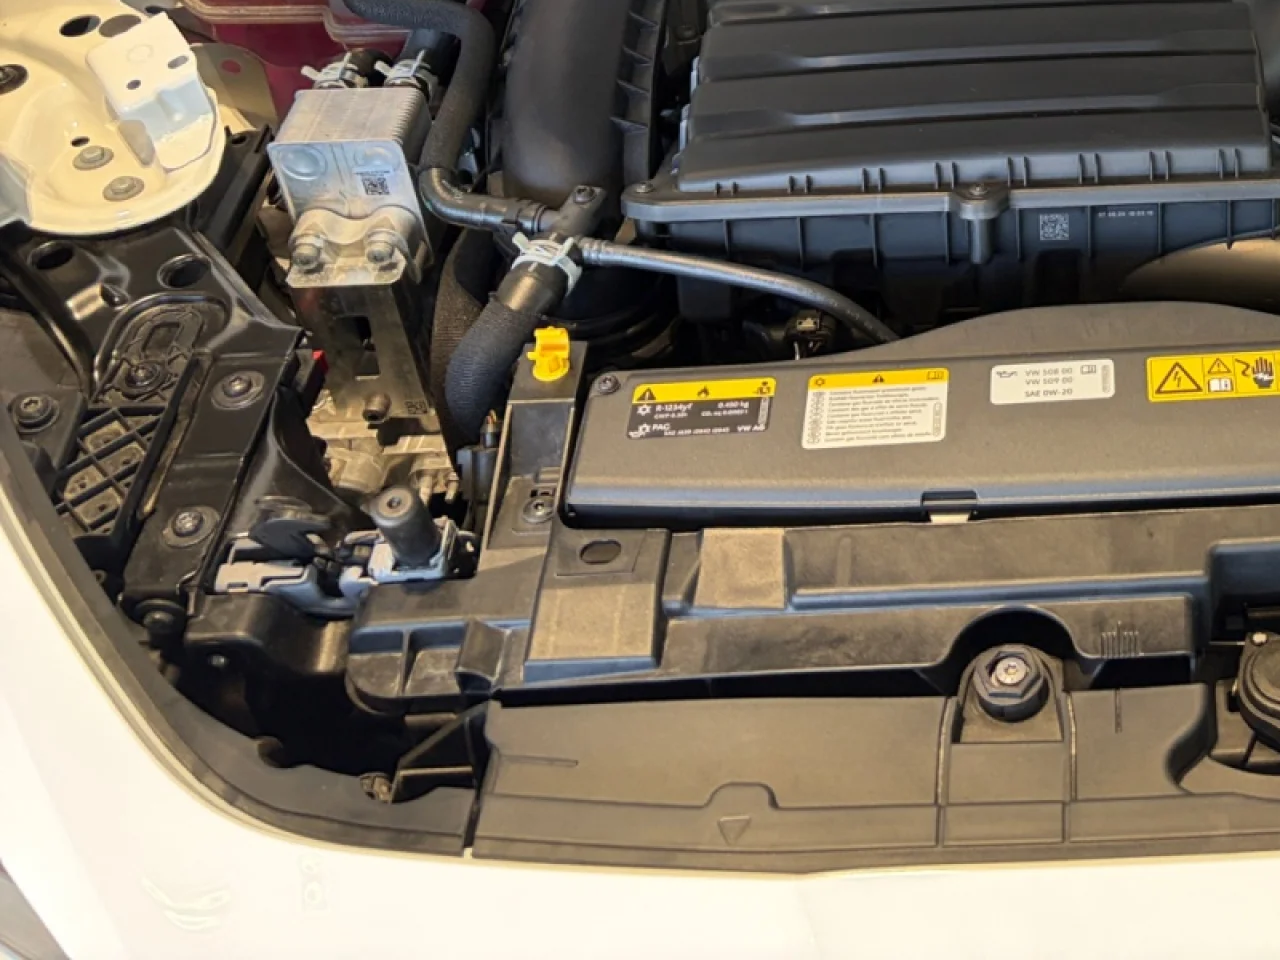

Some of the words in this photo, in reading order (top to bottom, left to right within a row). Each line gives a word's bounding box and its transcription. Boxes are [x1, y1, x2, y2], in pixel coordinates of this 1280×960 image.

[1025, 368, 1040, 377] VW
[1025, 377, 1040, 385] VW
[1043, 377, 1060, 385] 509
[1025, 389, 1040, 398] SAE
[655, 402, 693, 413] R-1234yf
